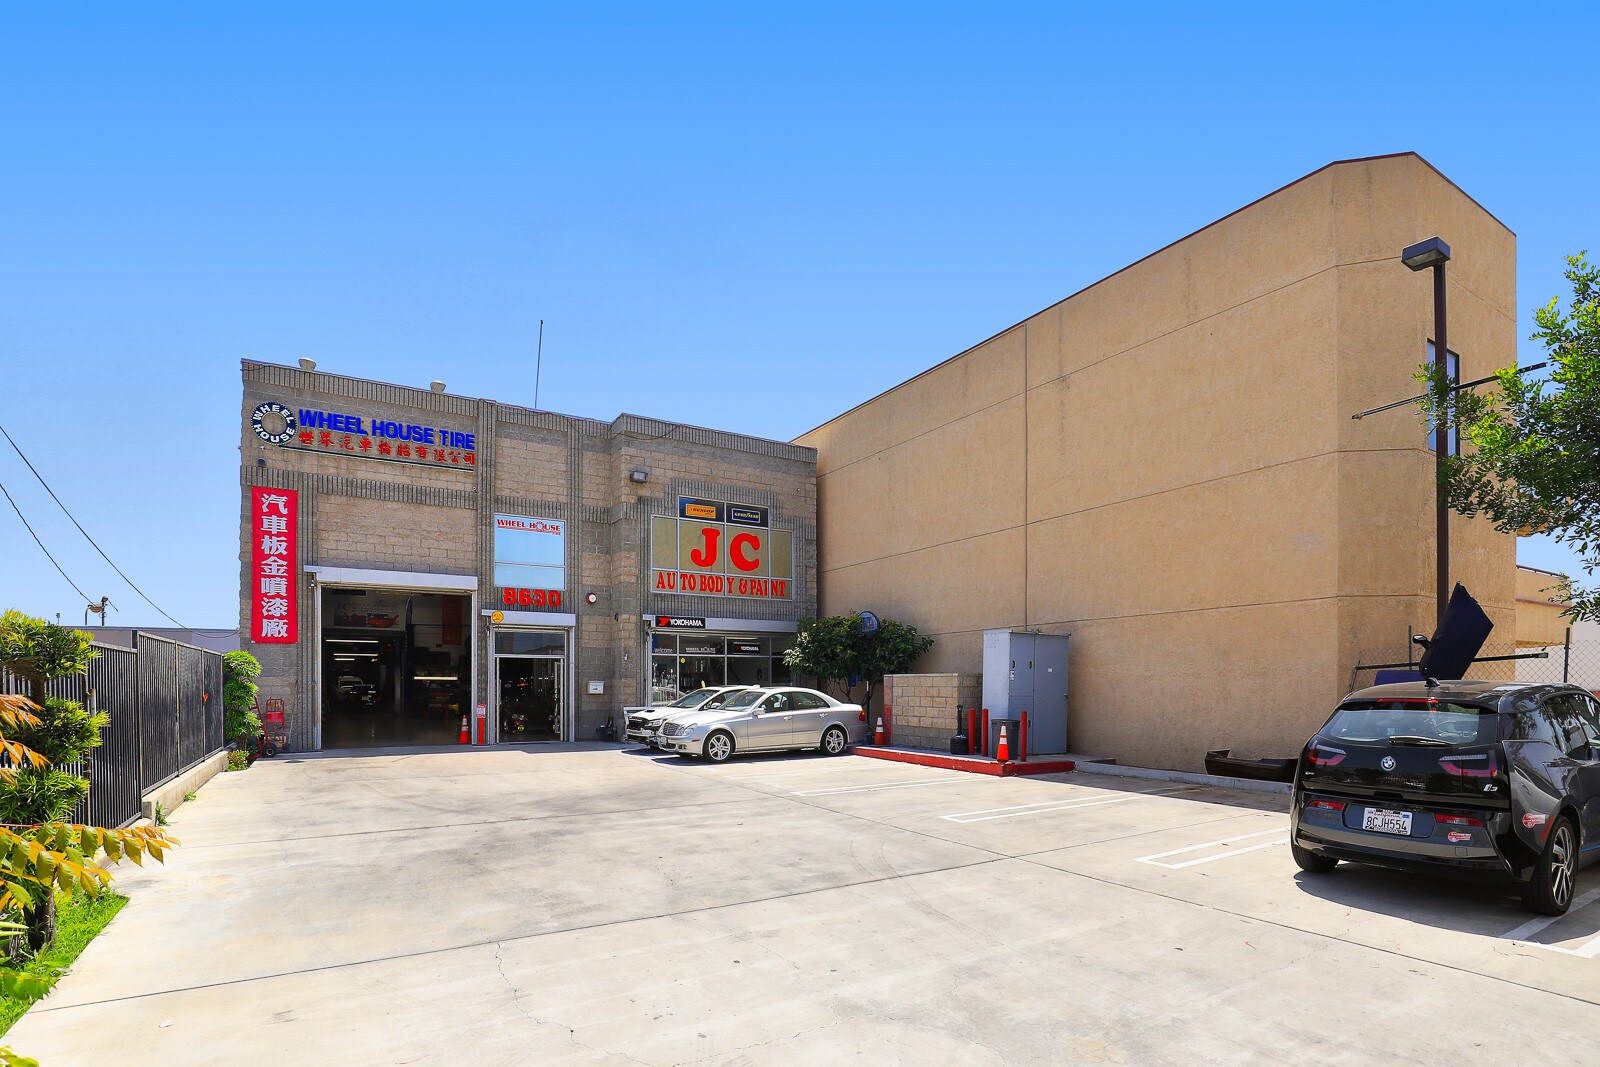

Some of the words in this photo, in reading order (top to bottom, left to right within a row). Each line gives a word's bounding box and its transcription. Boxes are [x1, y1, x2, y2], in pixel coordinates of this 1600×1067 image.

[253, 404, 294, 423] WHEEL
[253, 424, 296, 443] HOUSE
[298, 409, 368, 436] WHEEL
[372, 419, 434, 445] HOUSE
[439, 429, 475, 450] TIRE
[734, 511, 759, 519] GOODYEAR
[497, 519, 526, 528] WHEEL
[529, 521, 561, 532] HOUSE
[261, 493, 288, 638] 汽車板金噴漆廠
[656, 571, 697, 591] AUTO
[699, 575, 735, 594] BODY
[502, 587, 561, 607] 8630
[669, 618, 703, 627] YOKOHAMA
[1366, 816, 1407, 831] 8CJH554
